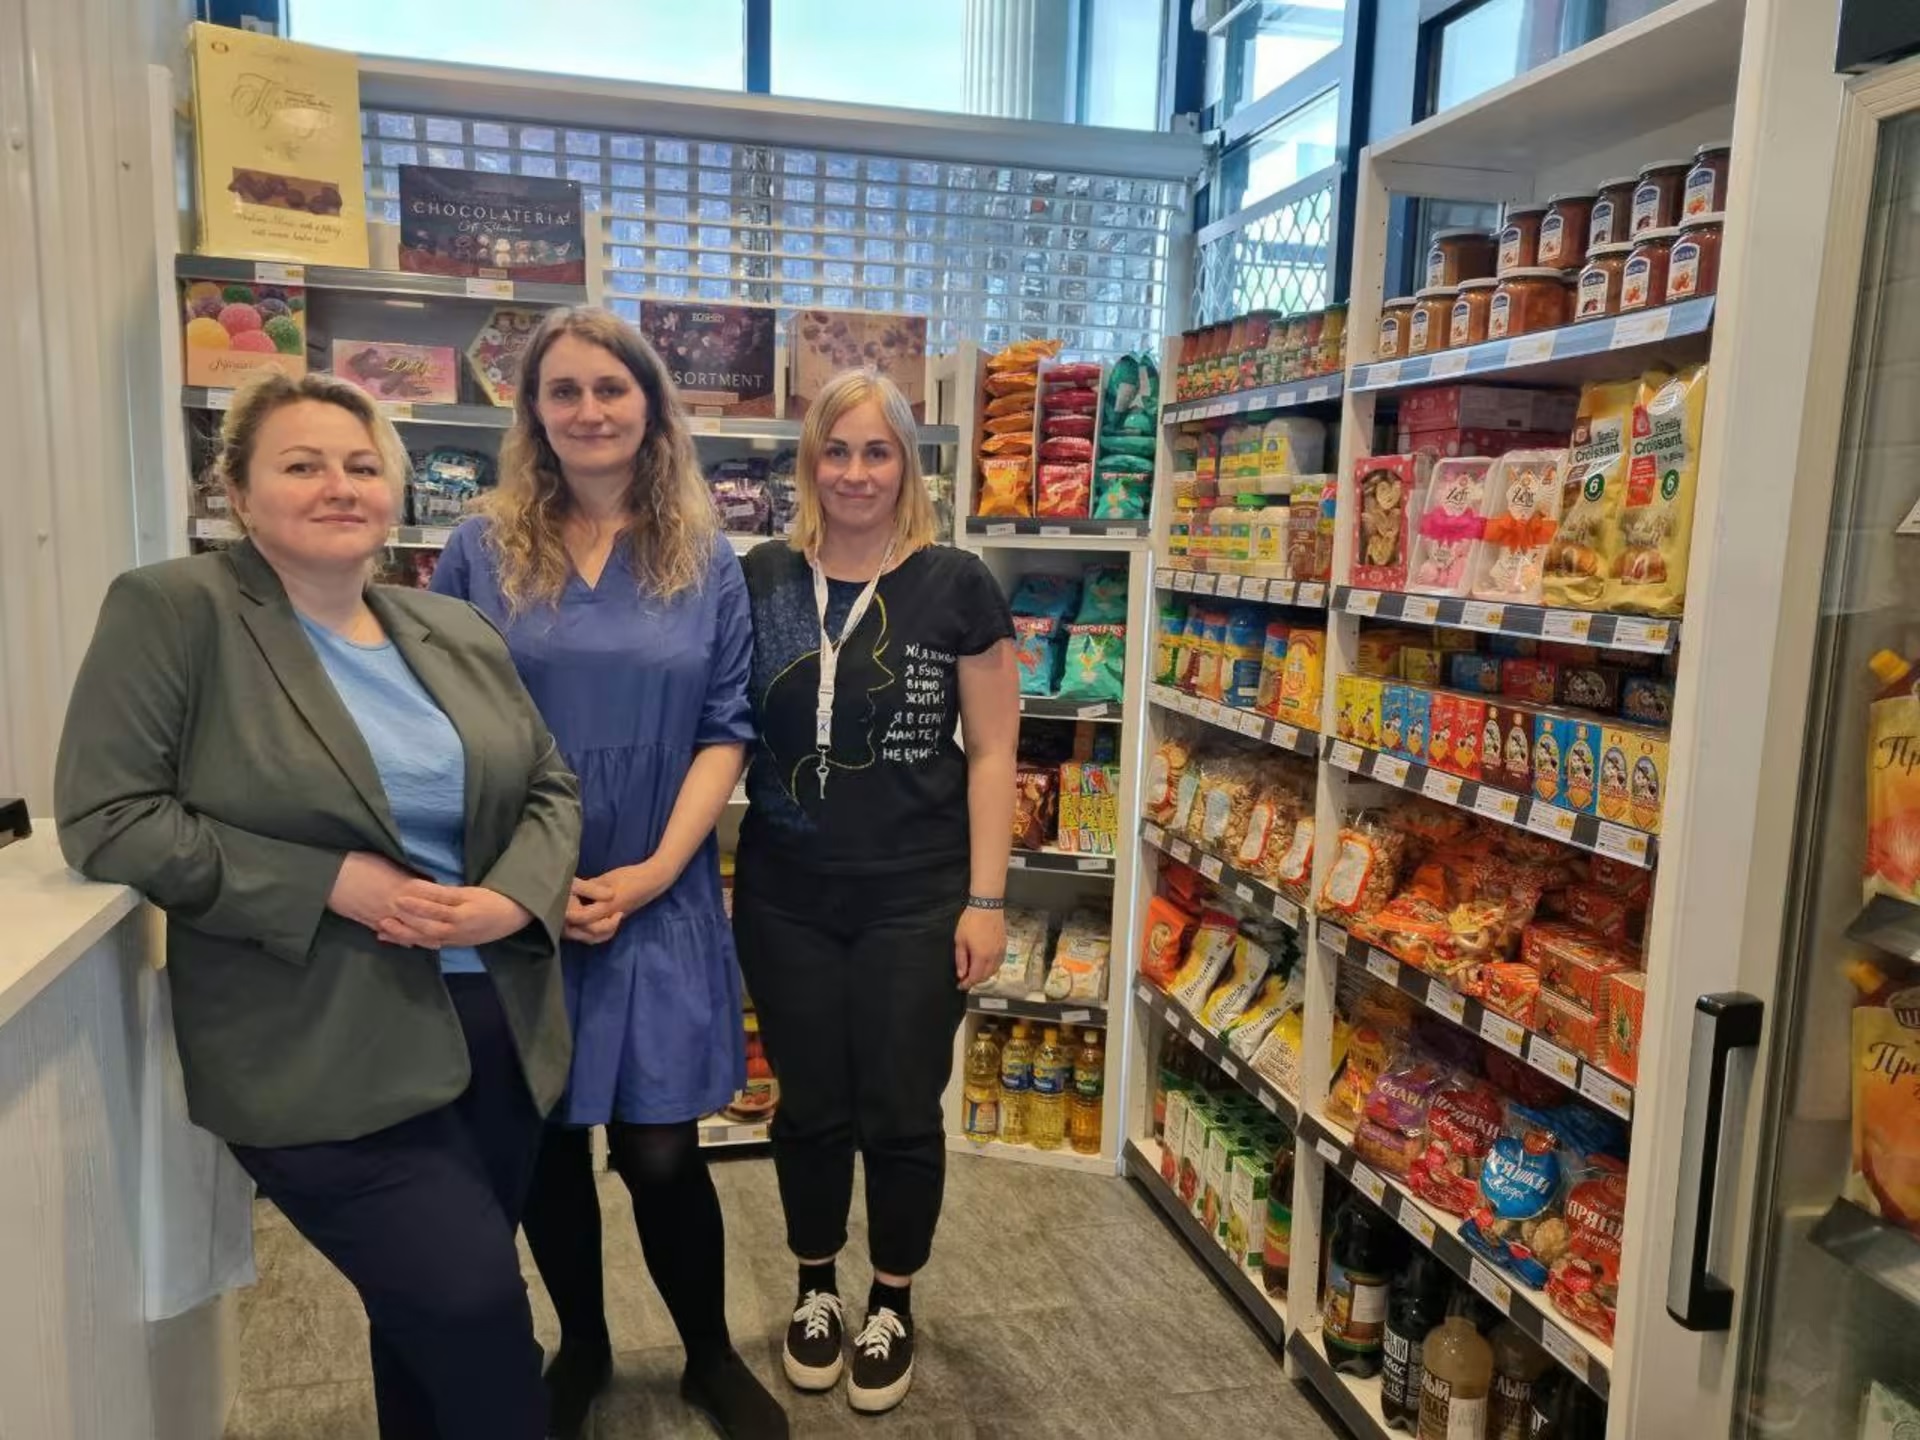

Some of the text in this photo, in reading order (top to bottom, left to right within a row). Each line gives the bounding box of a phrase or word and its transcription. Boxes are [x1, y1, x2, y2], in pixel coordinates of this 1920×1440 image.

[674, 371, 764, 388] SORTMENT
[1574, 443, 1620, 463] Croissant
[1633, 434, 1682, 456] Croissant
[1589, 479, 1599, 494] 6
[1667, 475, 1675, 488] 6
